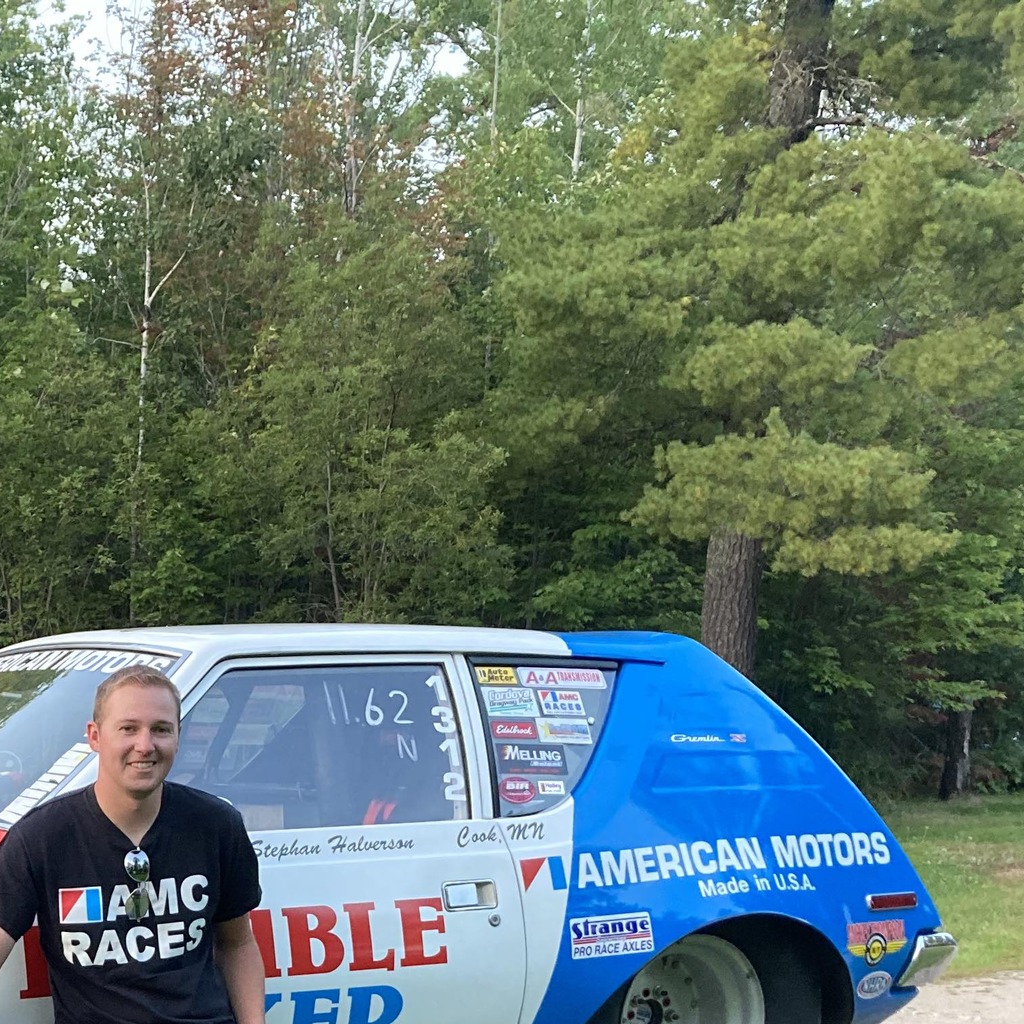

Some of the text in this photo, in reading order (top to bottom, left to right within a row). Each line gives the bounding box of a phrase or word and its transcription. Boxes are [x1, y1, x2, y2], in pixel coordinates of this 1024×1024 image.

[322, 680, 414, 726] 11.62
[559, 693, 578, 701] AMC
[496, 724, 533, 735] Edelbrock
[671, 733, 726, 743] Gremlin
[396, 732, 418, 762] N
[504, 745, 562, 761] MELLING
[506, 821, 545, 841] MN
[252, 835, 415, 861] Stephan Halverson
[577, 831, 891, 889] AMERICAN MOTORS
[698, 873, 816, 898] Made in U.S.A.
[106, 874, 209, 922] AMC
[571, 918, 650, 939] Strange
[61, 917, 206, 967] RACES
[573, 939, 653, 957] PRO RACE AXLES
